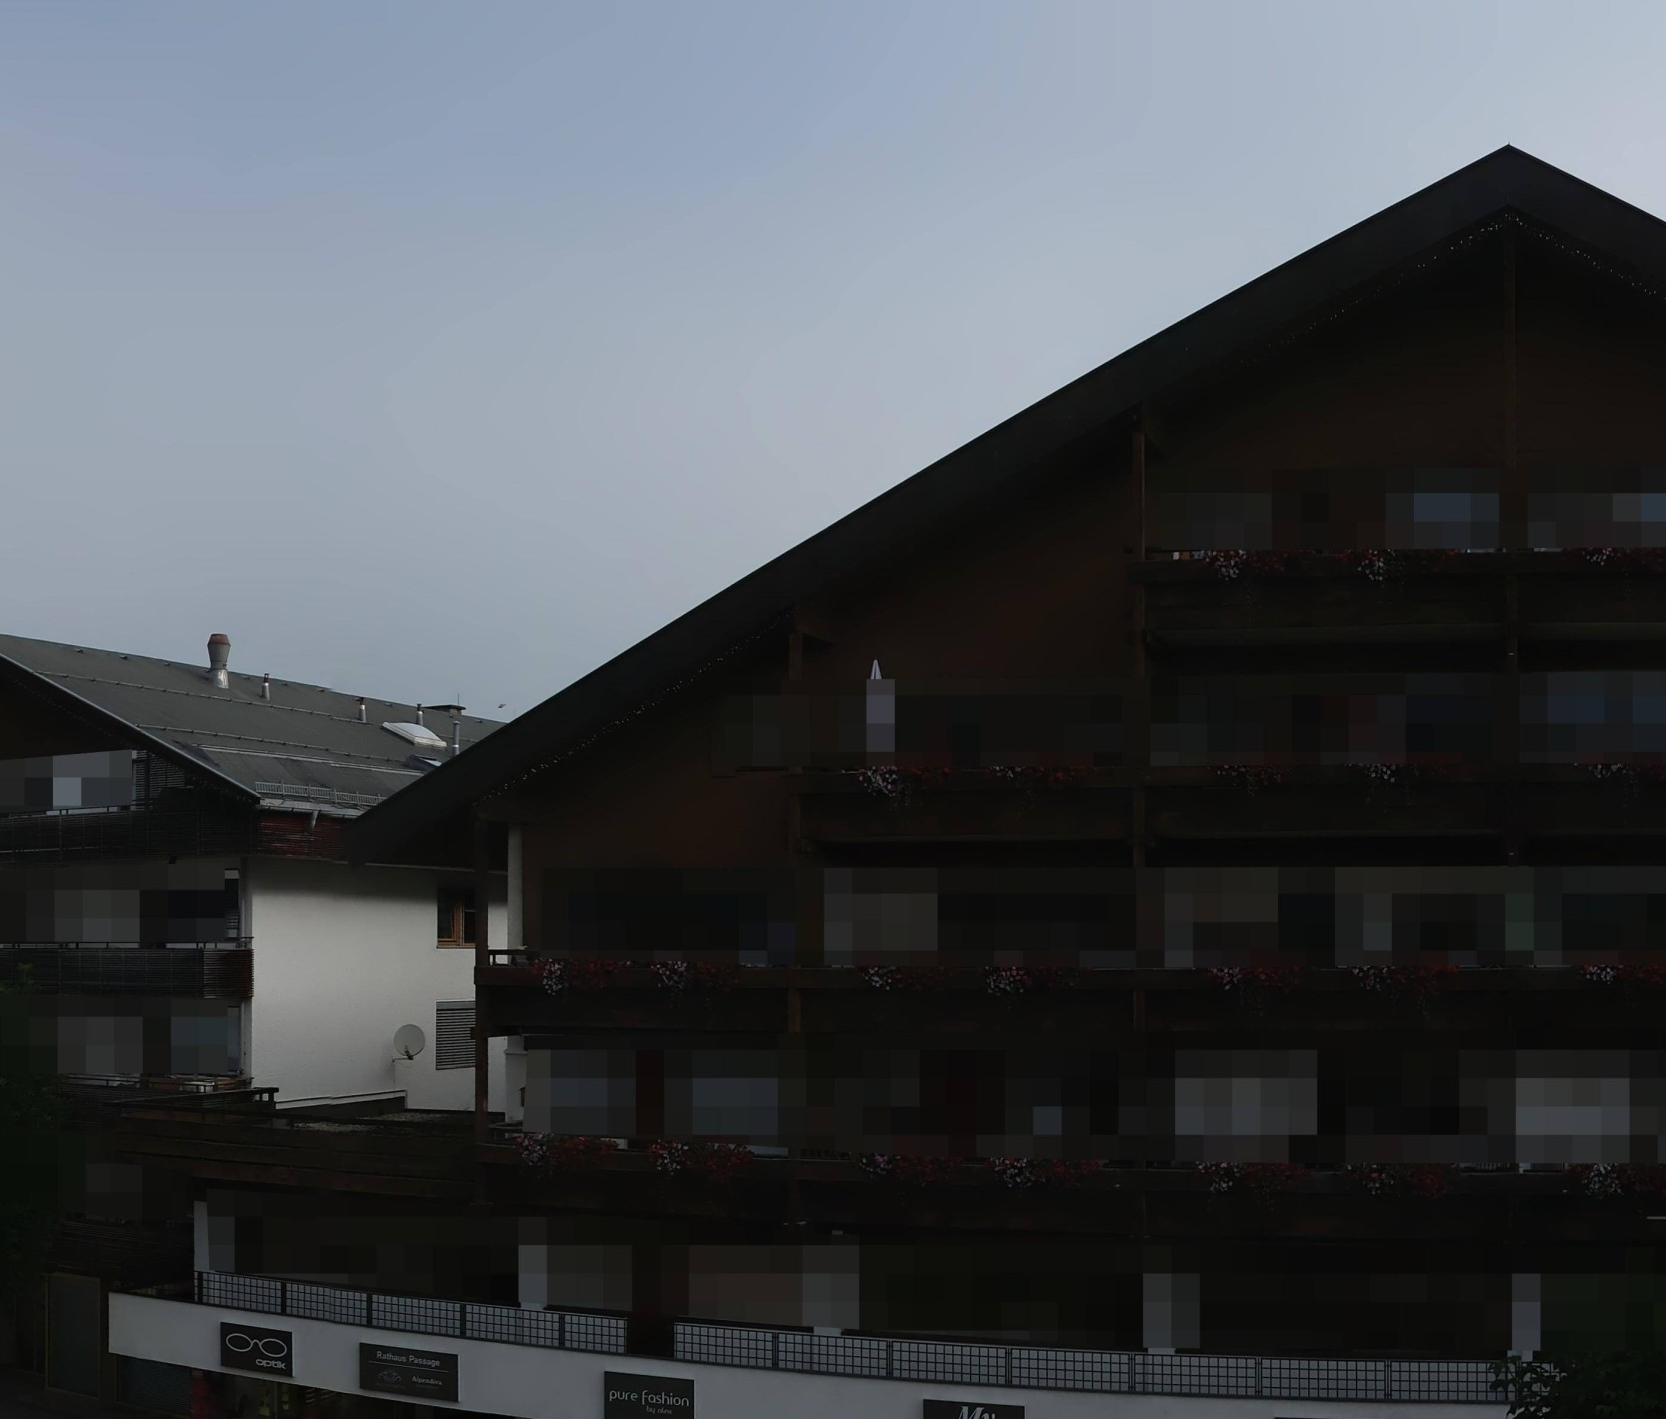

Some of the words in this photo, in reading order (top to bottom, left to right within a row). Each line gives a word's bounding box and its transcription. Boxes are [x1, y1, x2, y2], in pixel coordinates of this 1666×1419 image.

[255, 1358, 288, 1371] optik
[376, 1351, 406, 1363] Rathaus
[408, 1354, 441, 1368] Passage
[609, 1389, 638, 1403] pure
[641, 1389, 690, 1407] fashion
[646, 1405, 656, 1415] by
